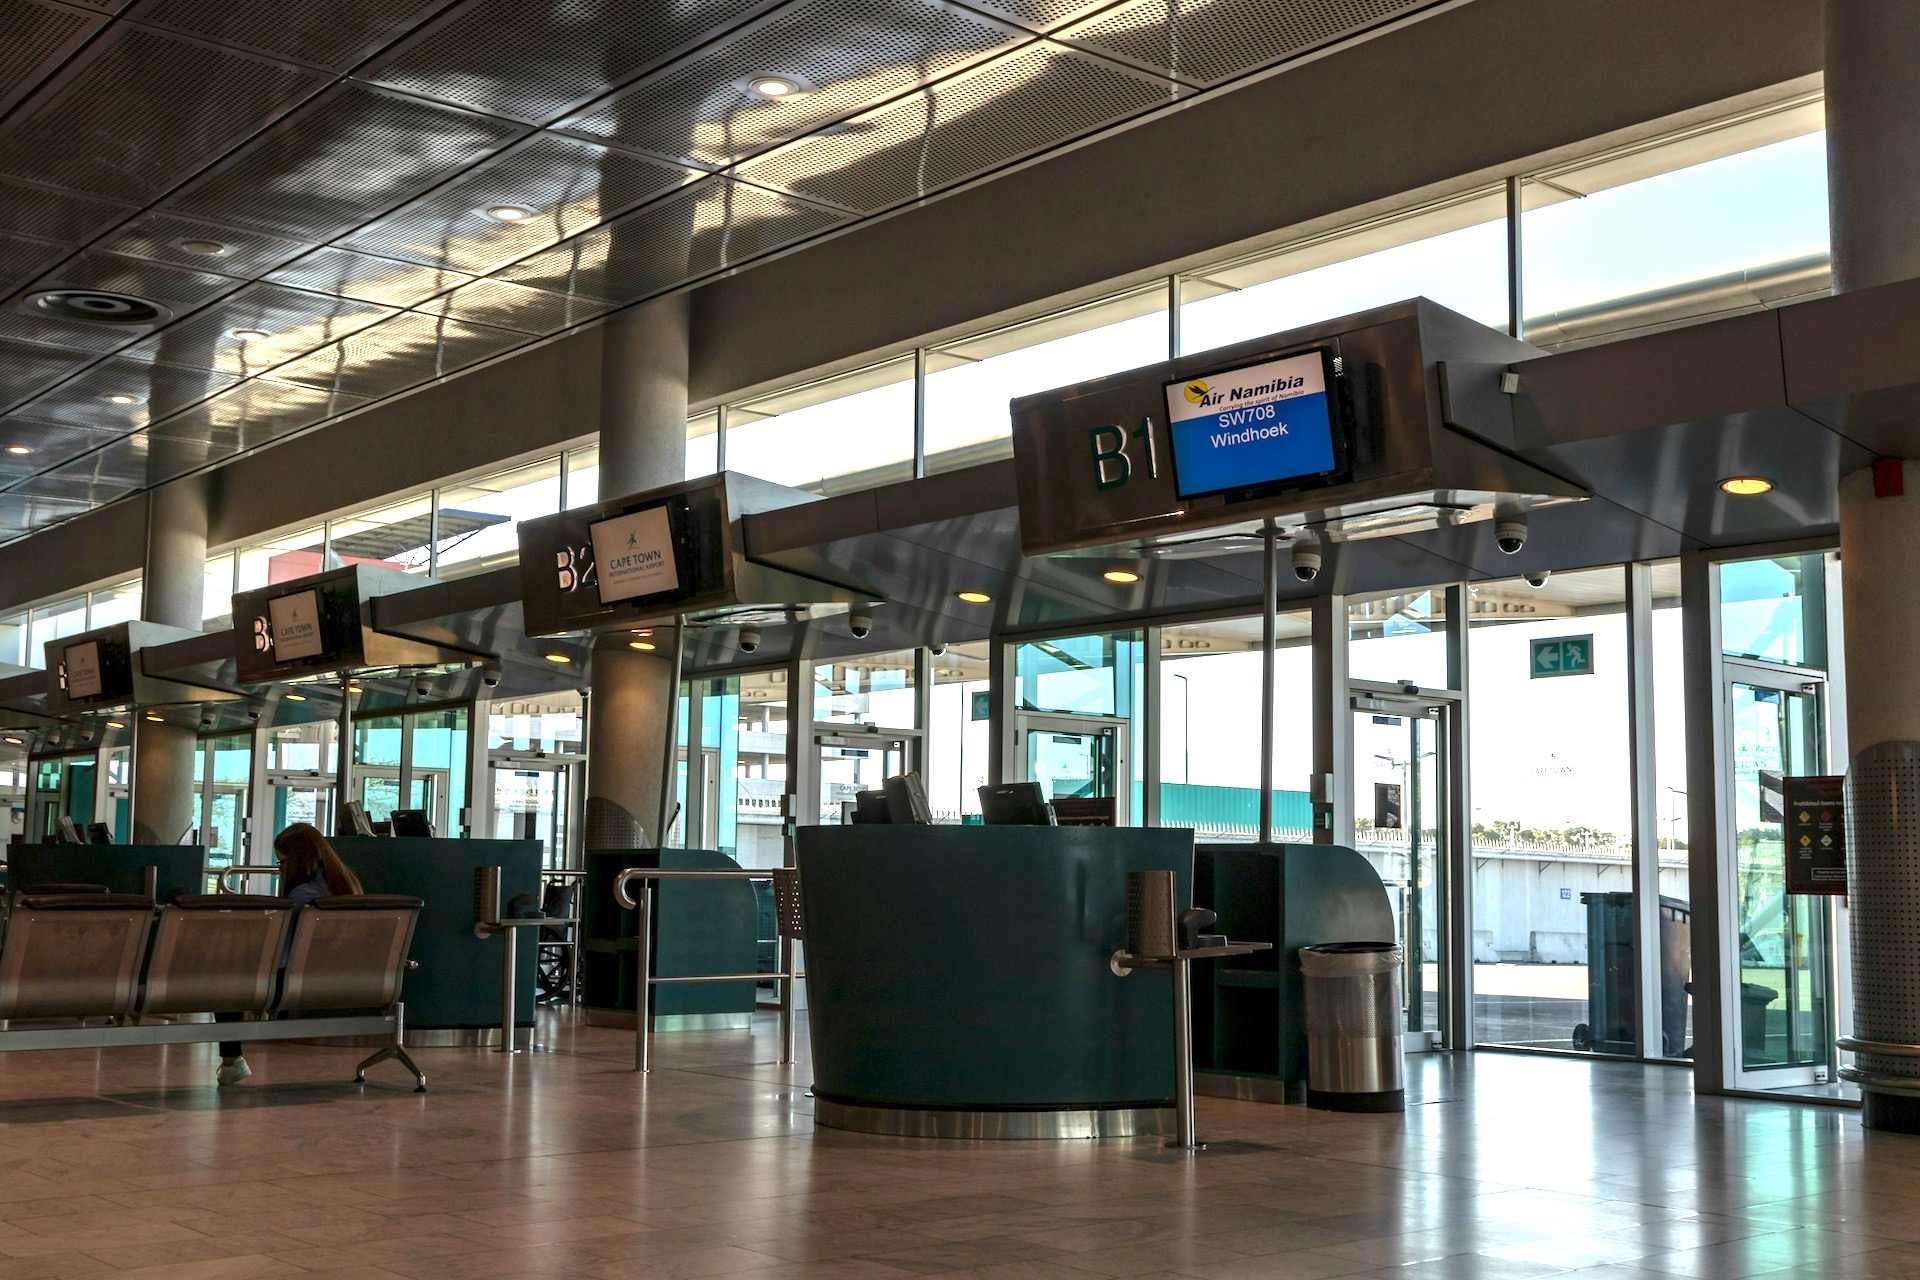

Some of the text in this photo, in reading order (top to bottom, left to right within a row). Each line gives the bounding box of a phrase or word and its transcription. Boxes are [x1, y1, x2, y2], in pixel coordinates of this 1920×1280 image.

[1199, 376, 1304, 408] Air Namibia
[1219, 402, 1244, 412] Carrying
[1255, 397, 1271, 405] spirit
[1279, 390, 1305, 399] Namibia
[1218, 404, 1276, 428] SW708
[1210, 422, 1289, 449] Windhoek
[1089, 416, 1157, 491] B1
[608, 565, 645, 578] INTERNATIONAL
[645, 560, 665, 570] AIRPORT
[610, 549, 662, 569] CAPE TOWN
